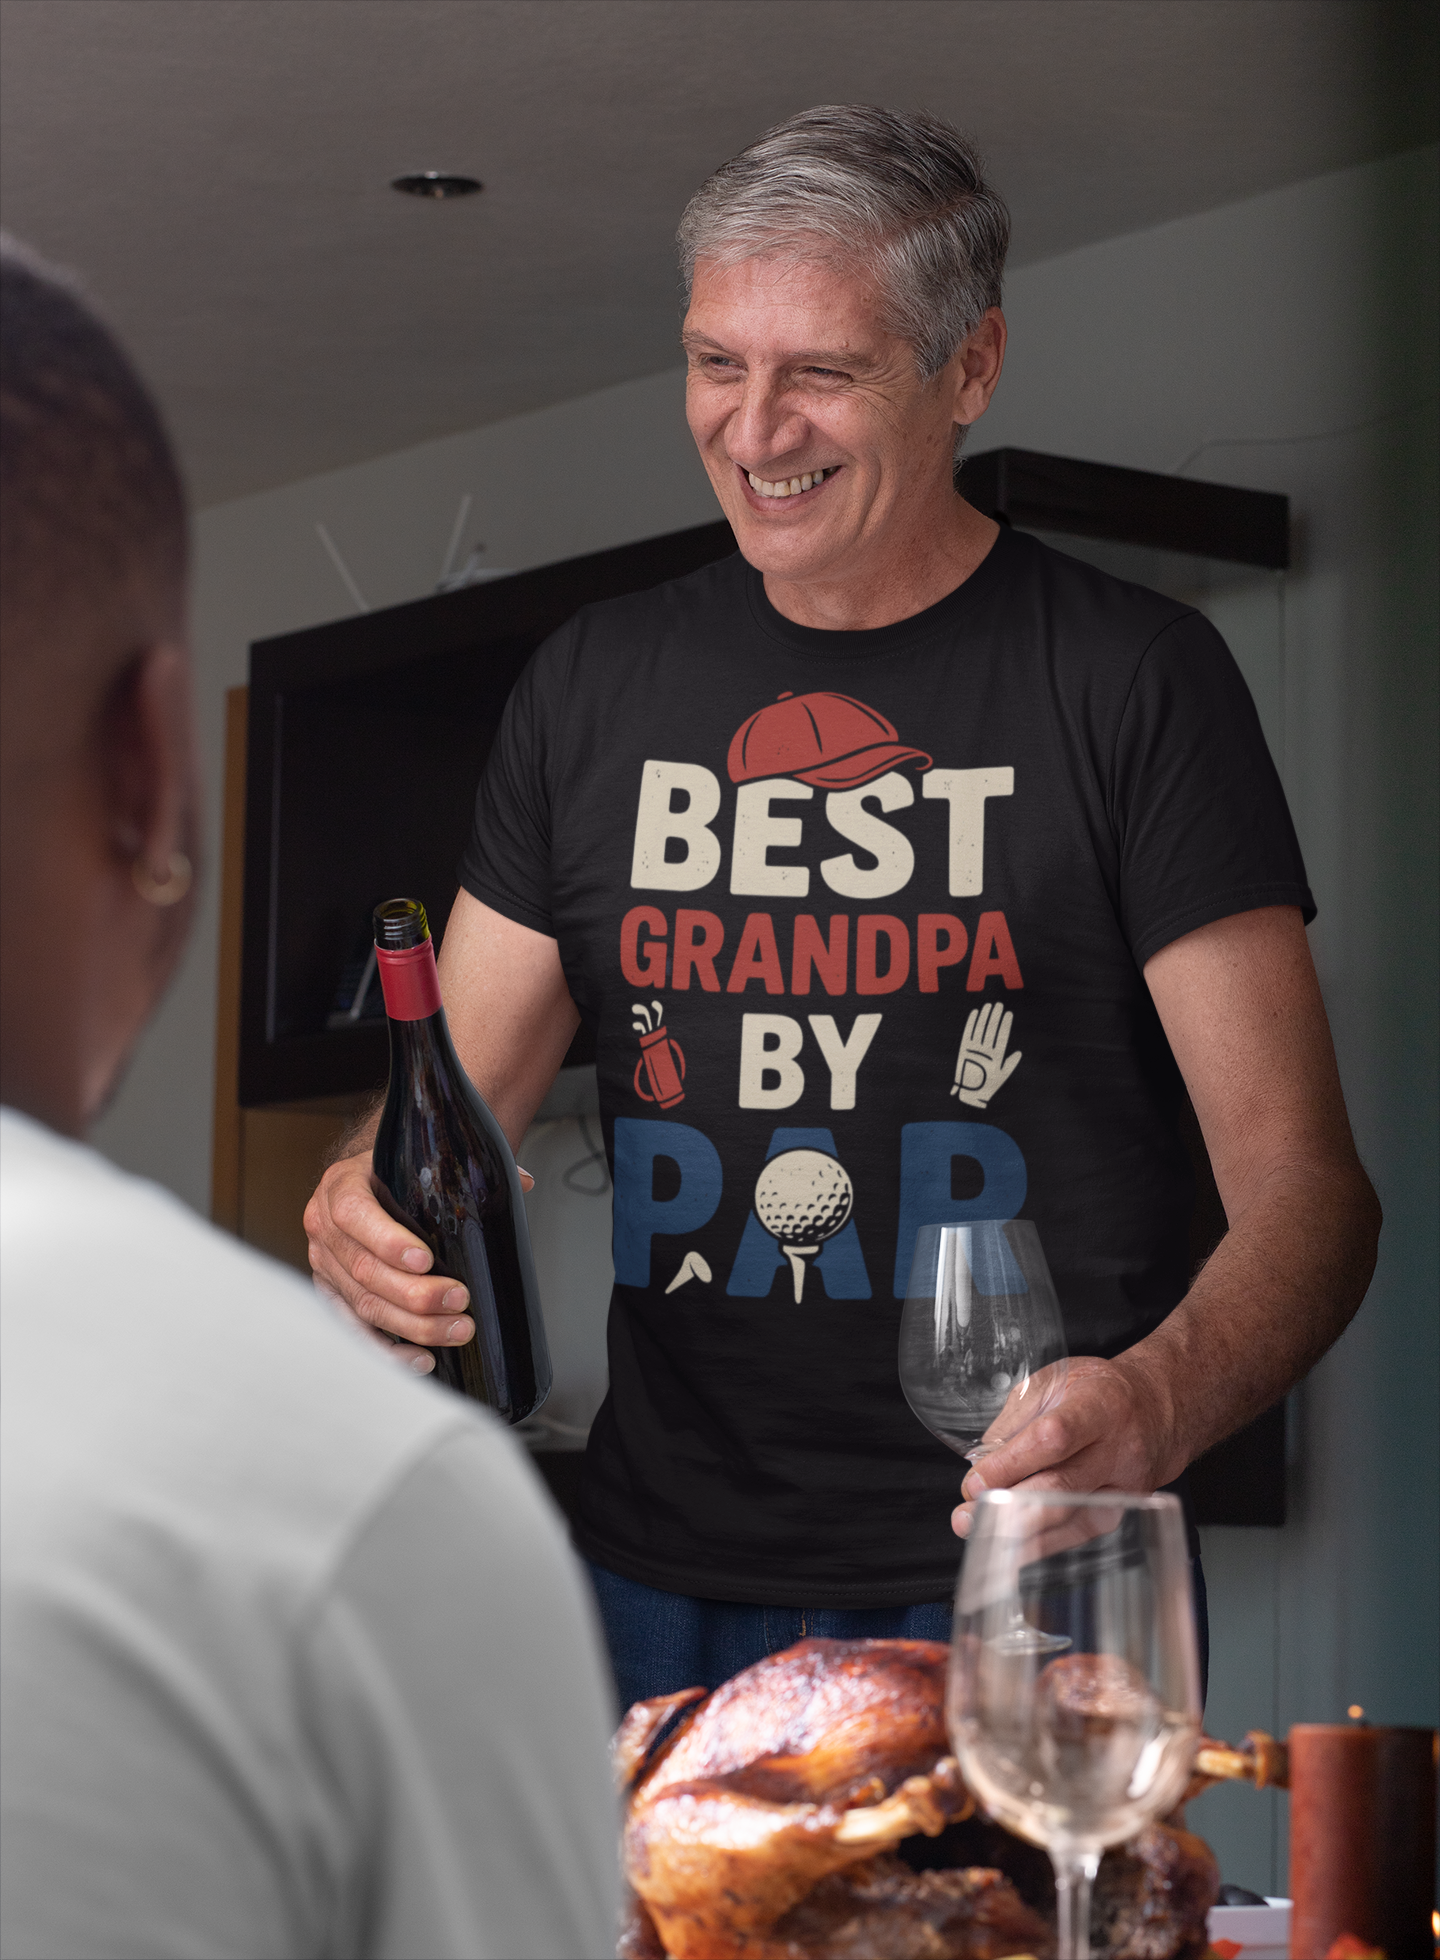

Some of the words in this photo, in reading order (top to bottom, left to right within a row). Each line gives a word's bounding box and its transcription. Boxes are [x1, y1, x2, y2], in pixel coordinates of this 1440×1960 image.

[630, 759, 1015, 899] BEST
[620, 905, 1024, 995] GRANDPA
[739, 1012, 883, 1110] BY
[613, 1117, 1028, 1299] PAR
